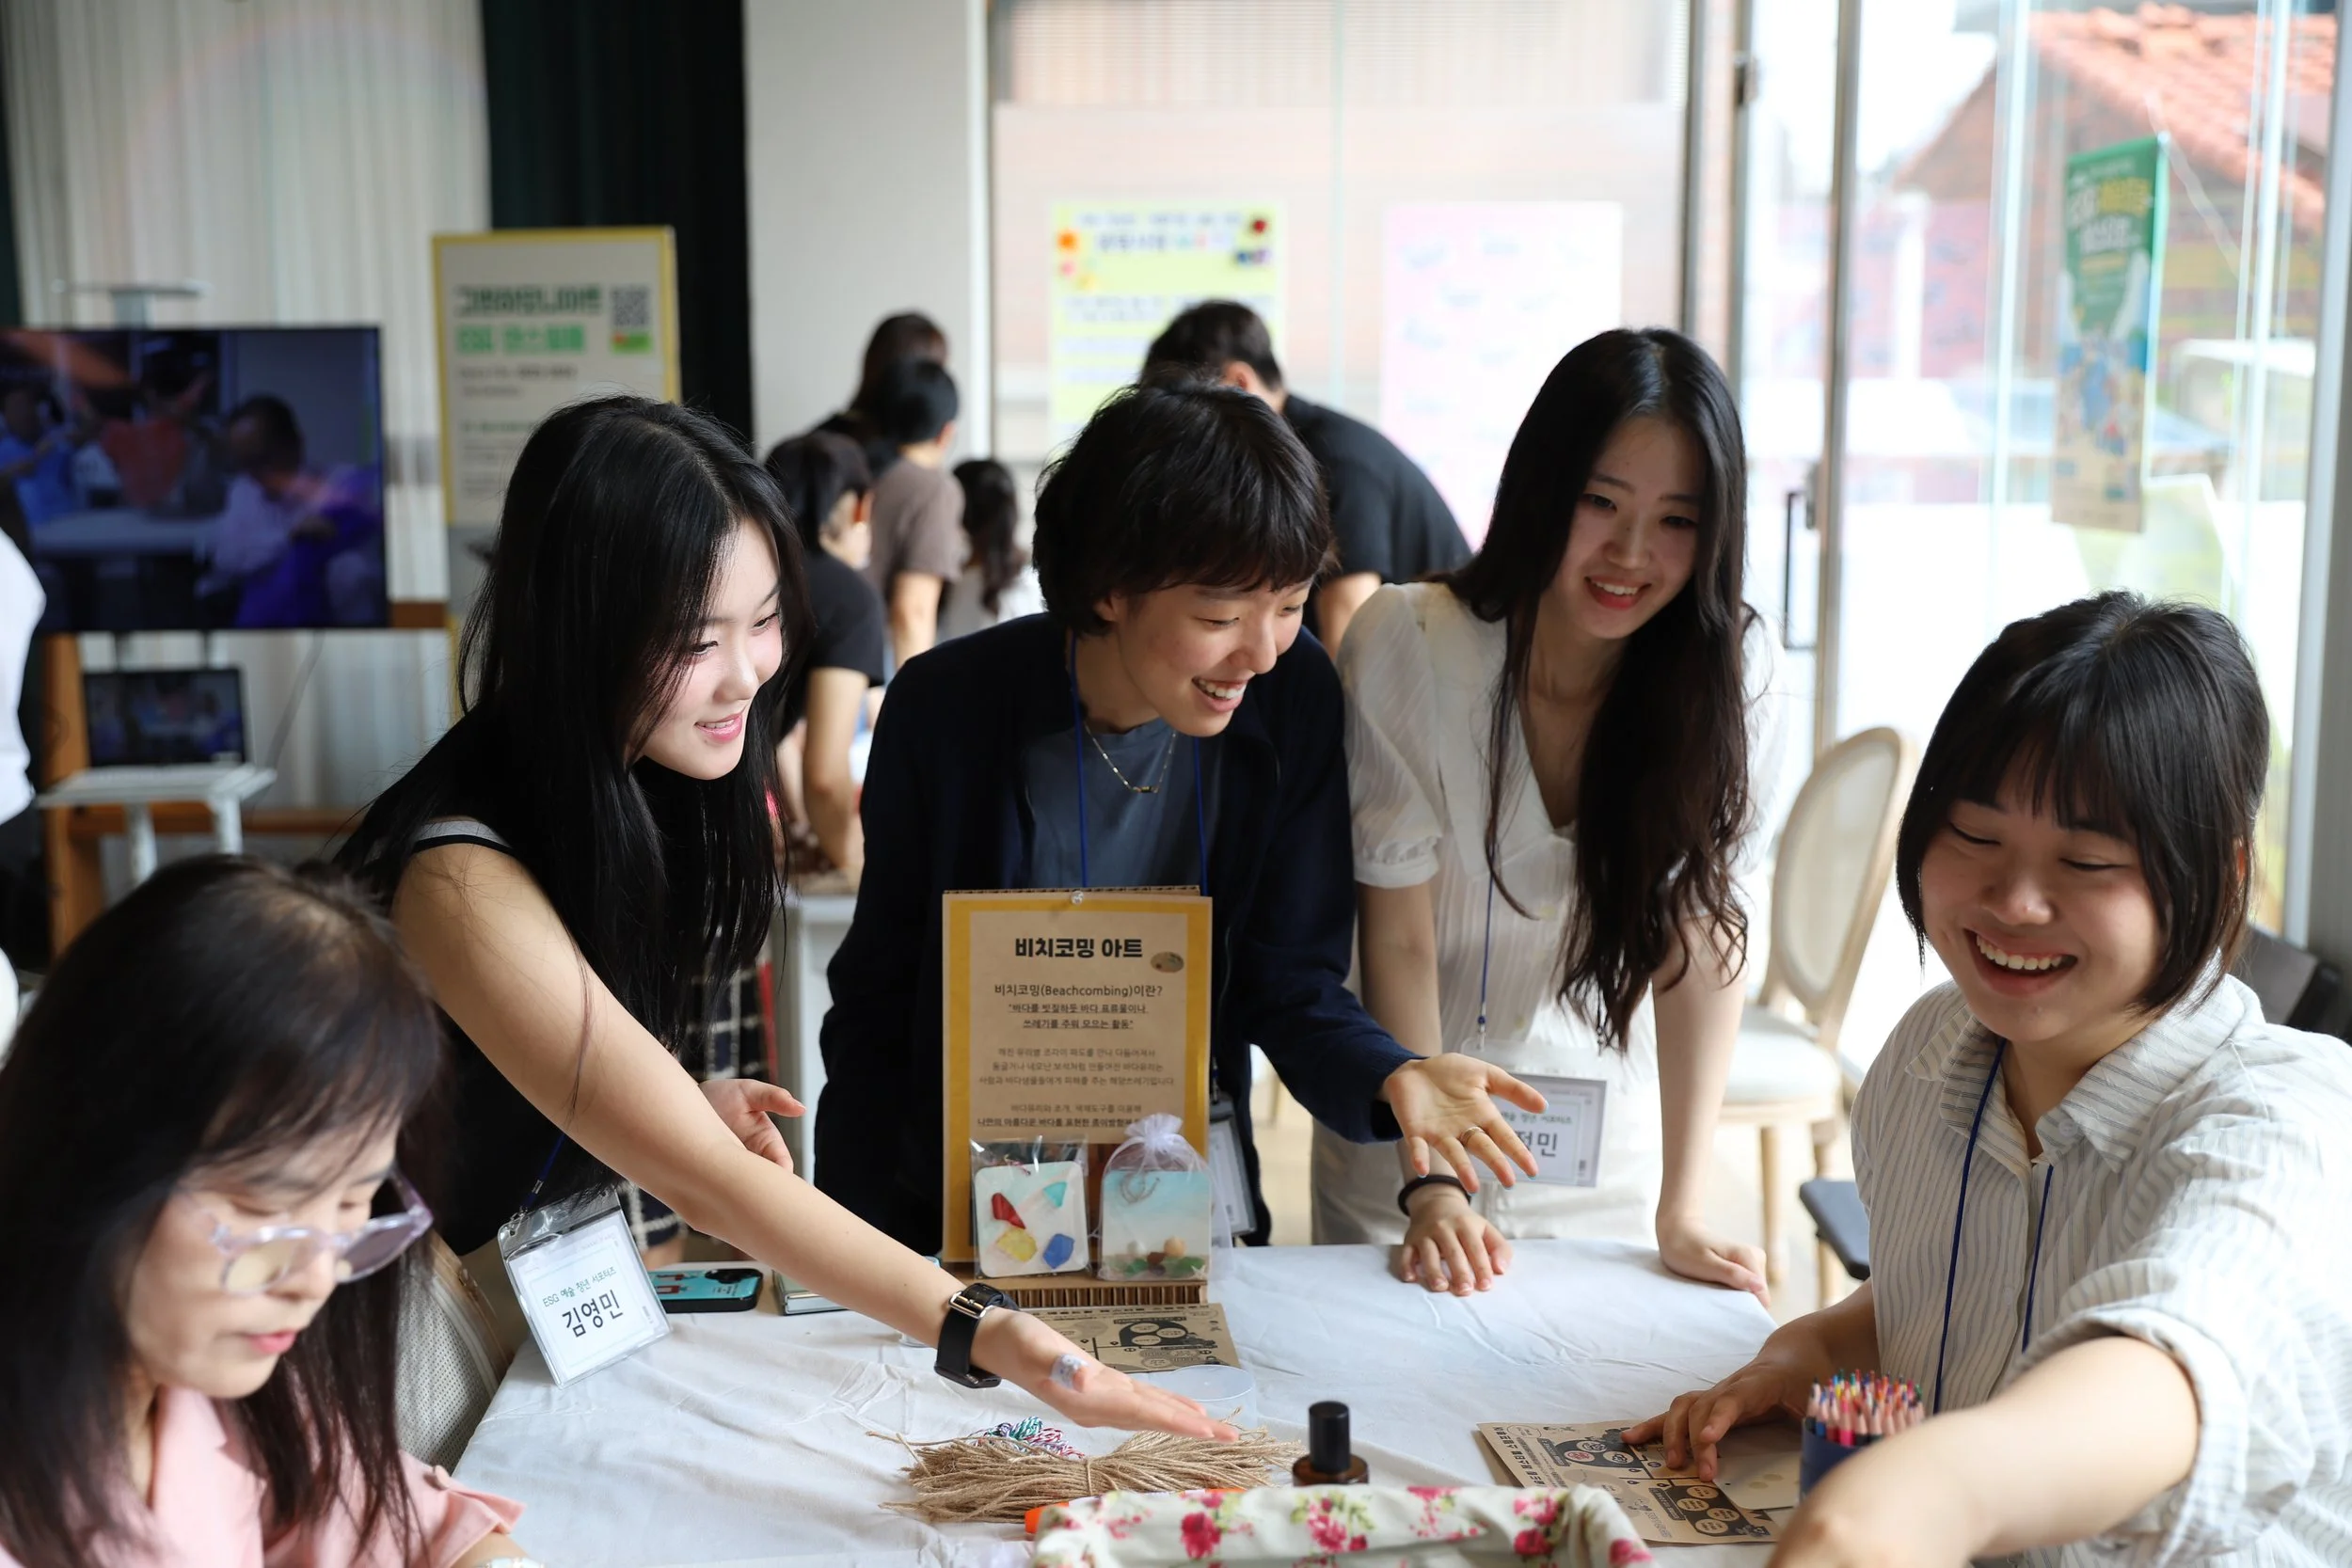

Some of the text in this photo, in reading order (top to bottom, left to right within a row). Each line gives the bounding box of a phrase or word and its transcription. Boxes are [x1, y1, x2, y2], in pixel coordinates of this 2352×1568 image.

[1014, 938, 1144, 959] 비치코밍 아트
[994, 983, 1163, 998] 비치코밍(Beachcombing)이란?
[1041, 1003, 1078, 1014] 빗질하듯
[1080, 1004, 1099, 1014] 바다
[1101, 1003, 1147, 1014] 표류물이나
[1023, 1019, 1058, 1030] 쓰레기를
[1061, 1019, 1080, 1030] 주워
[1082, 1019, 1109, 1030] 모으는
[542, 1267, 617, 1308] ESG 예술 청년 서포터즈
[562, 1290, 624, 1338] 김영민
